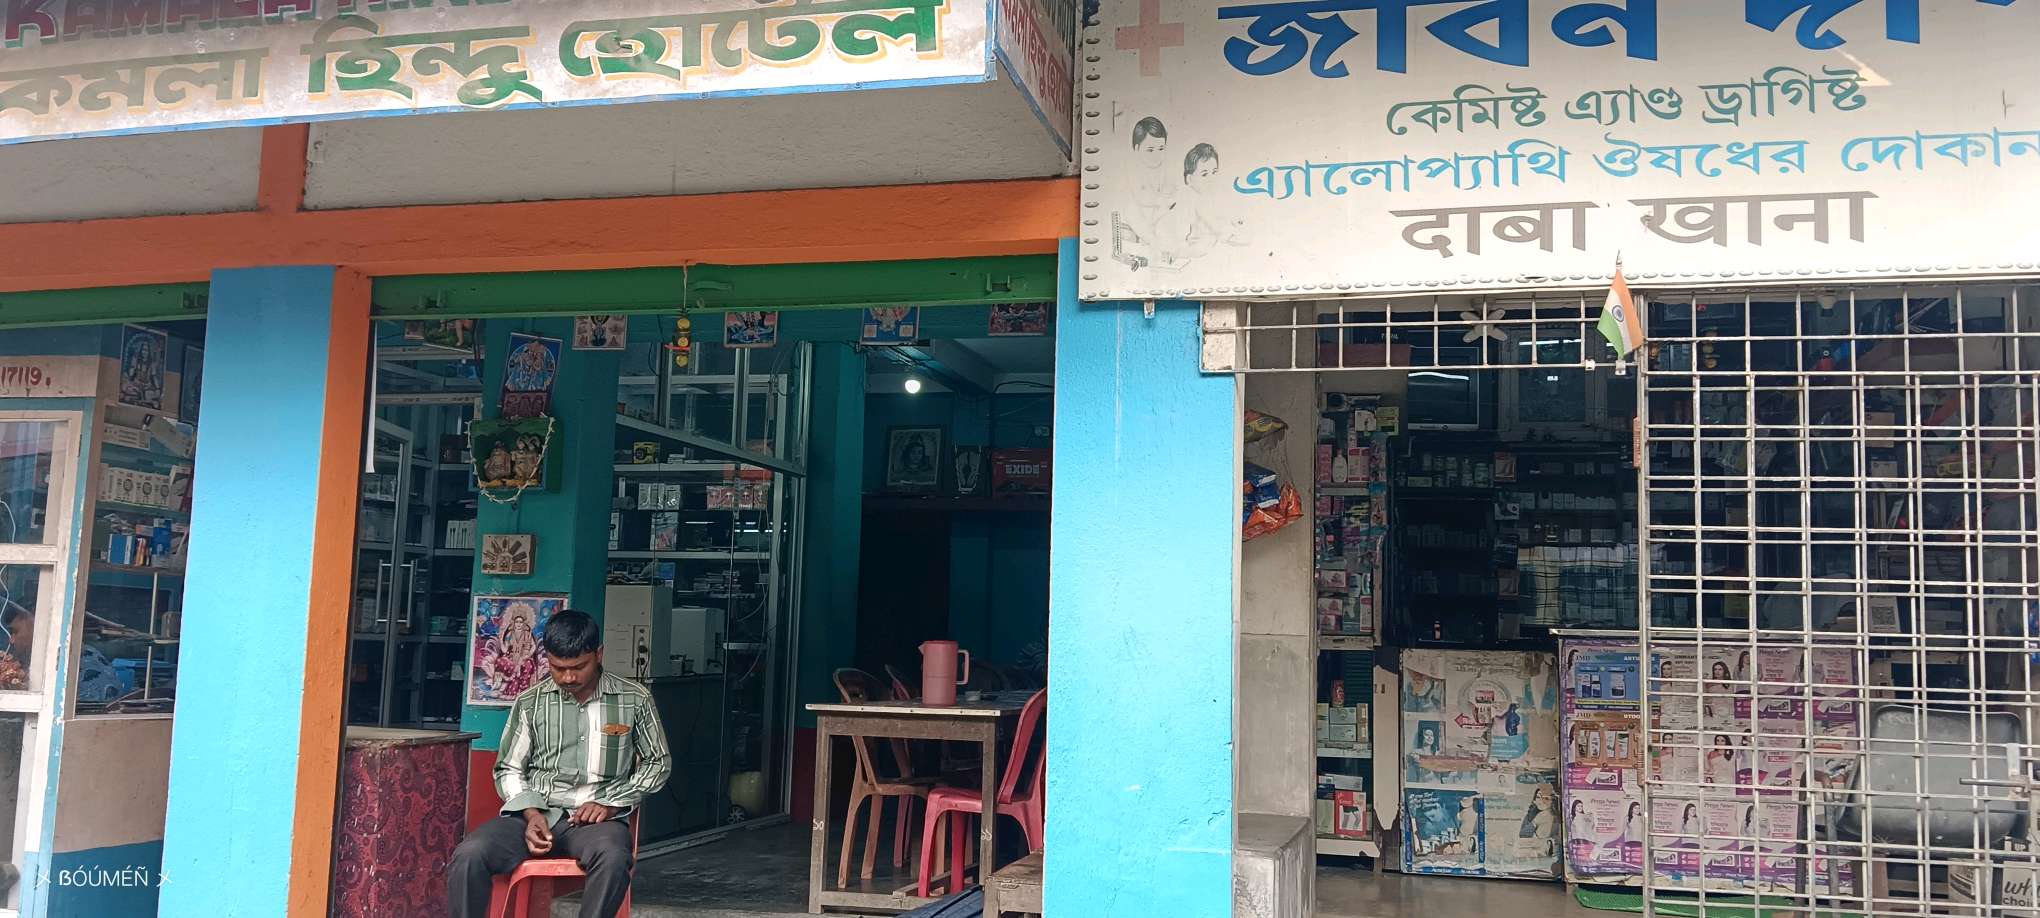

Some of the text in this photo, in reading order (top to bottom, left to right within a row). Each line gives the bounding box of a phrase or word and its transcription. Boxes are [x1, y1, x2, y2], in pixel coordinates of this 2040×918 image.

[0, 47, 269, 115] কমলা
[300, 14, 543, 106] হিন্দু
[559, 0, 944, 81] হোটেল
[1386, 83, 1547, 135] কেমিষ্ট
[1698, 64, 1867, 127] ড্রাগিষ্ট
[1233, 127, 2040, 200] এ্যালোপ্যাথি ঔষধের দোকান
[1389, 190, 1880, 258] दाबा खाना
[1004, 464, 1040, 475] EXIDE
